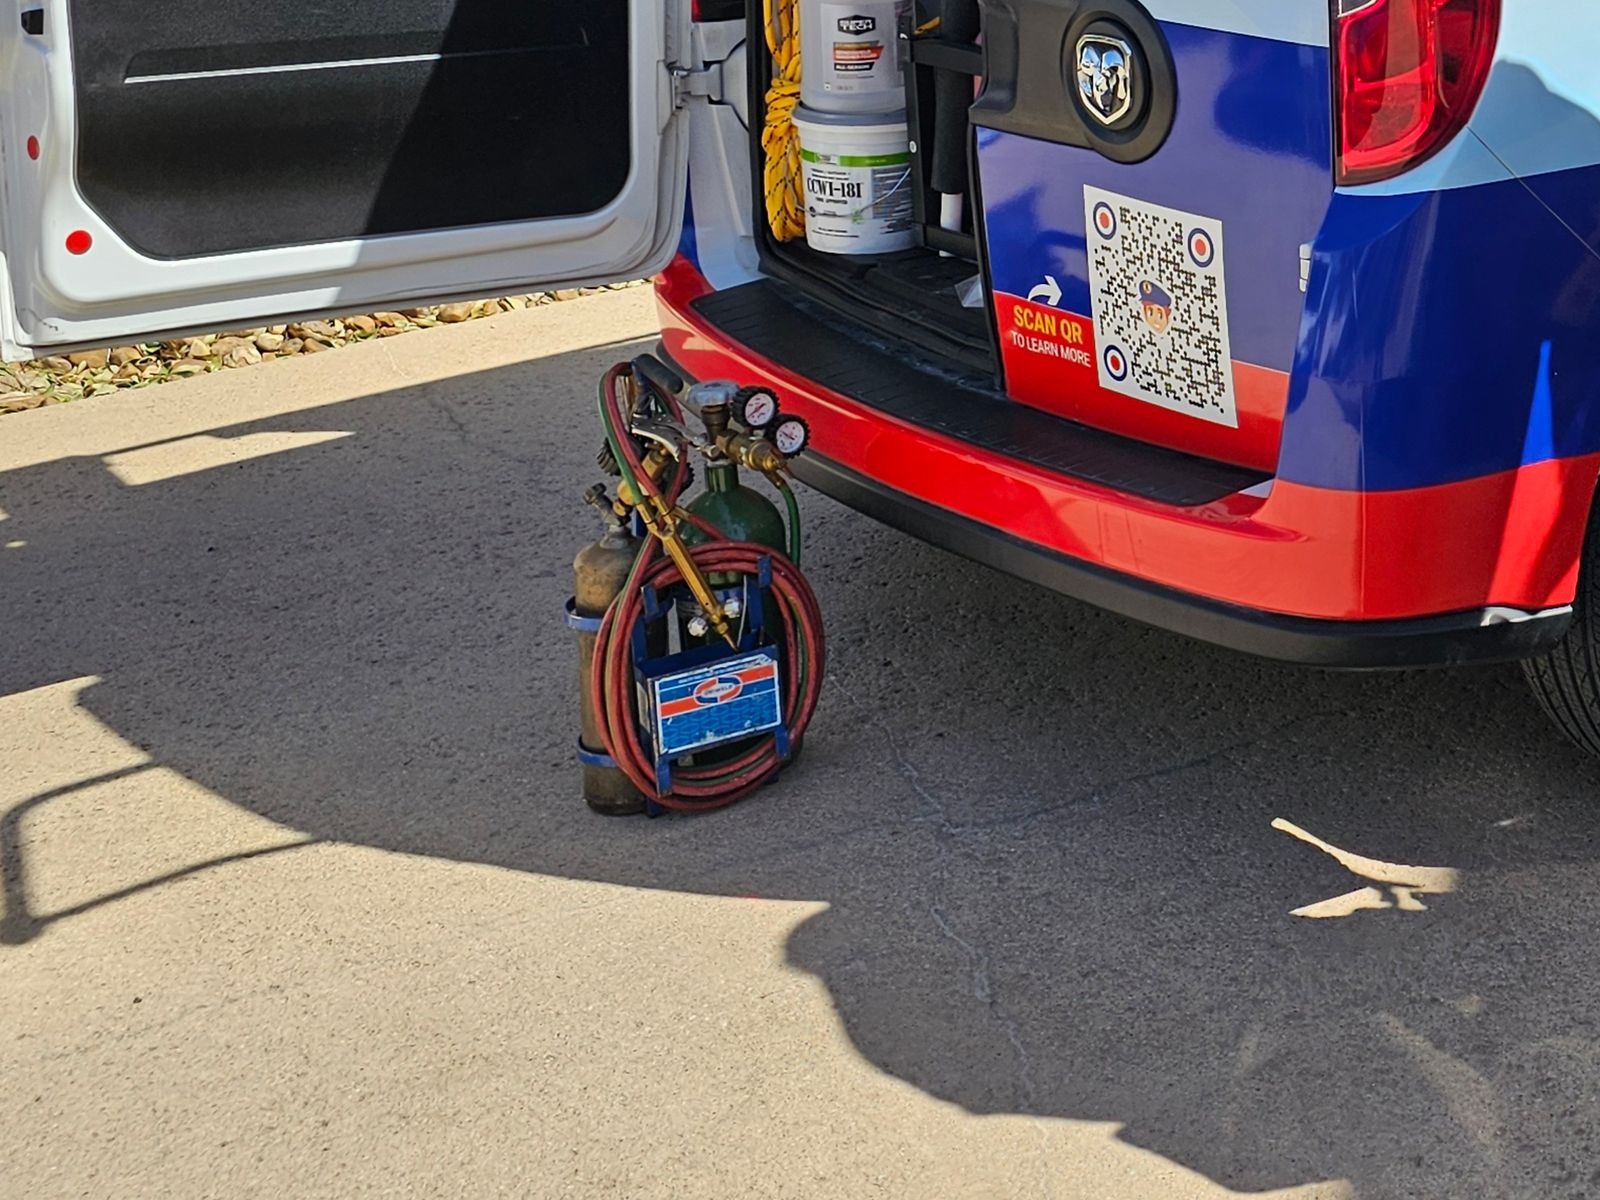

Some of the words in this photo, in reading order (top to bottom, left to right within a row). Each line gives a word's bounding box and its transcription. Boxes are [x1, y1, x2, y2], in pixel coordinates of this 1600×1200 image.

[1013, 305, 1057, 337] SCAN
[1060, 318, 1084, 345] QR
[1010, 330, 1026, 348] TO
[1026, 336, 1060, 358] LEARN
[1060, 345, 1092, 368] MORE
